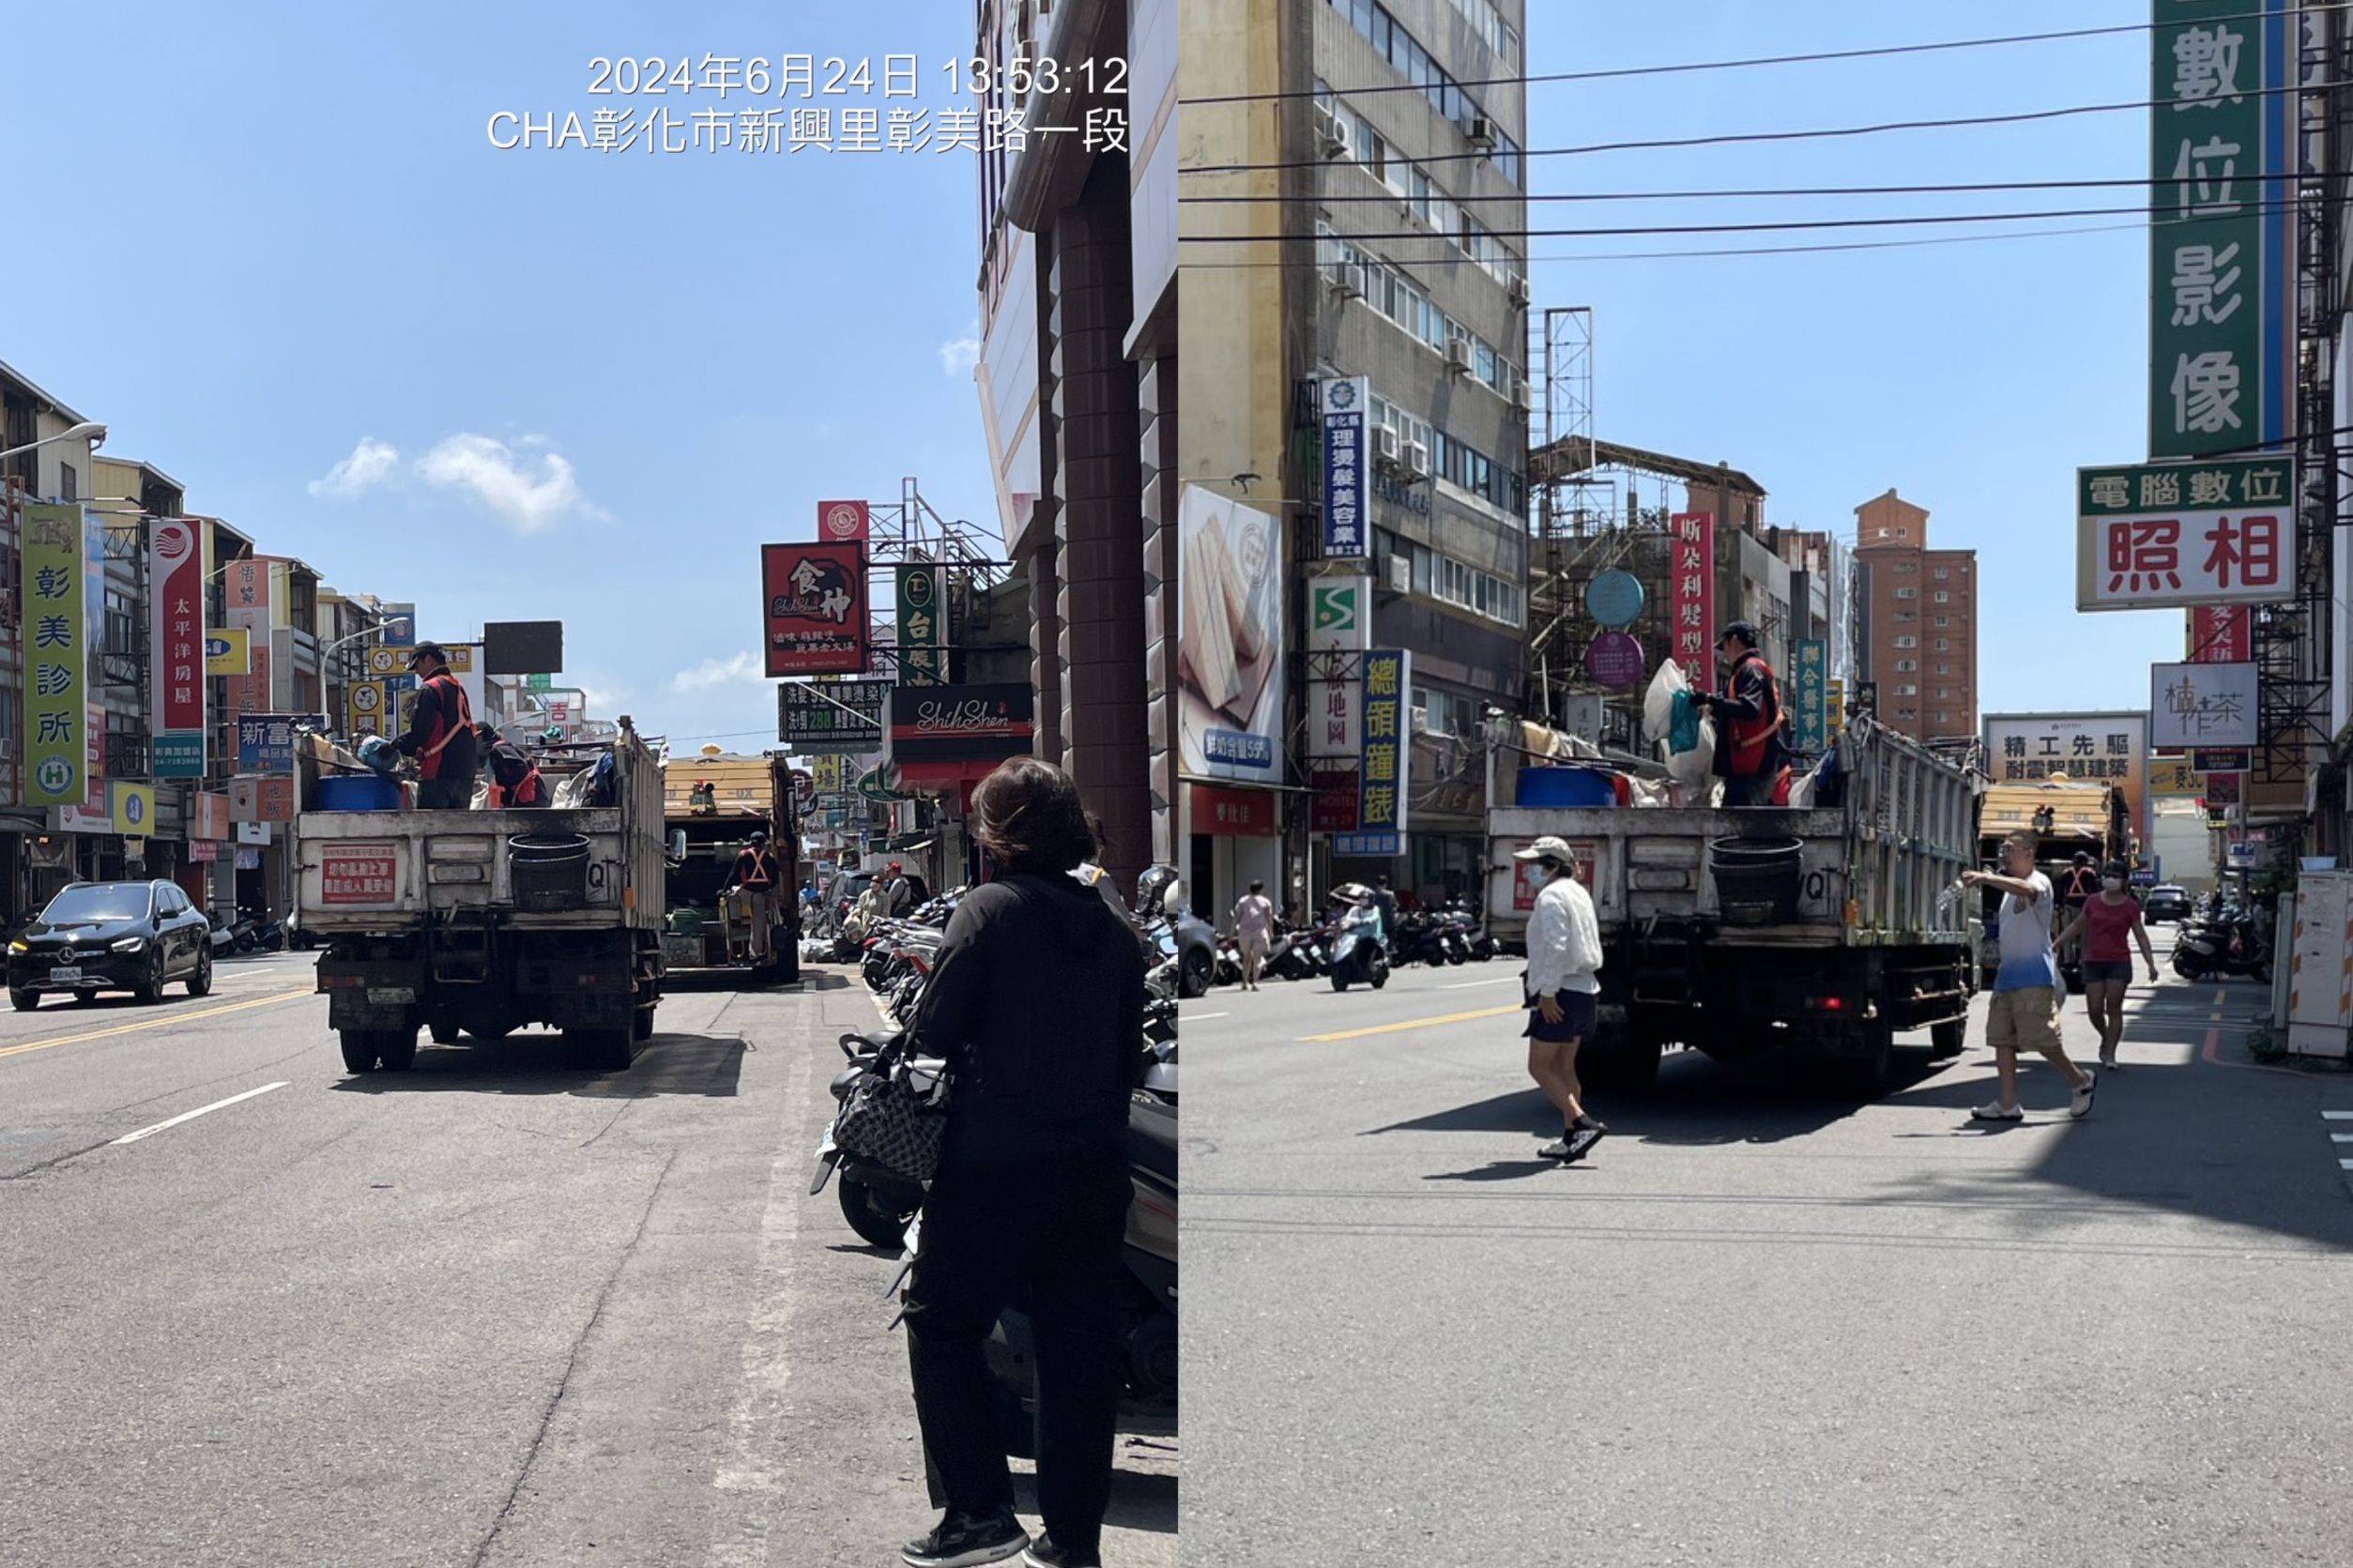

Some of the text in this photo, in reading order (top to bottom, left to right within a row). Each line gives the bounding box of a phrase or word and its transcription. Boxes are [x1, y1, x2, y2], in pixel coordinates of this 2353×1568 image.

[2171, 24, 2243, 434] 數位影像
[2088, 467, 2284, 510] 電腦數位
[2108, 516, 2279, 593] 照相
[789, 559, 851, 623] 食神
[35, 565, 72, 744] 彰美診所
[173, 598, 192, 705] 太平洋房屋
[809, 710, 833, 730] 288
[916, 699, 1010, 732] ShihShen
[1364, 657, 1398, 824] 總領鐘錶
[2005, 734, 2130, 758] 精工先驅
[2006, 758, 2129, 780] 耐震智慧建築
